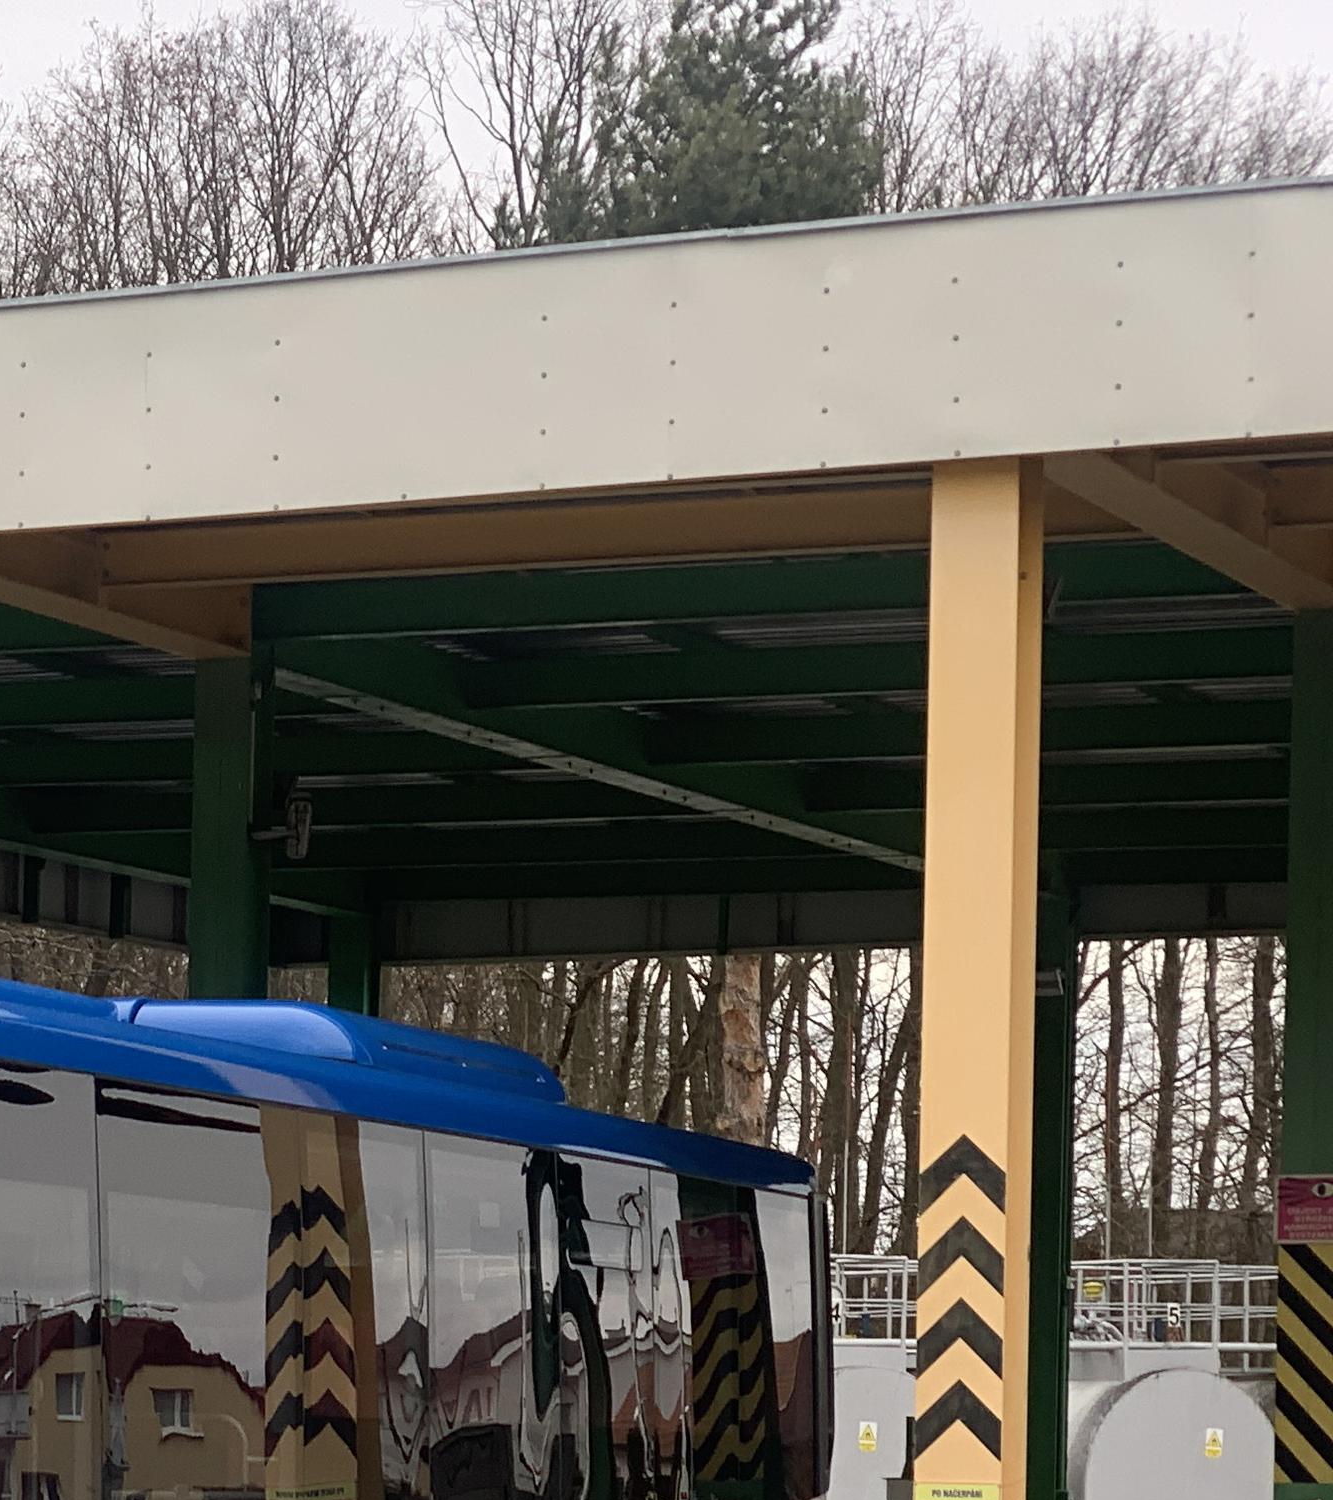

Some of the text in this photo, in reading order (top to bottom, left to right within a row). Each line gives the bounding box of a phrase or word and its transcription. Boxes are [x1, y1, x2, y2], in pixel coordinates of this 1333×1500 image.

[831, 1302, 841, 1322] 4
[1169, 1307, 1180, 1326] 5
[932, 1489, 941, 1497] PO
